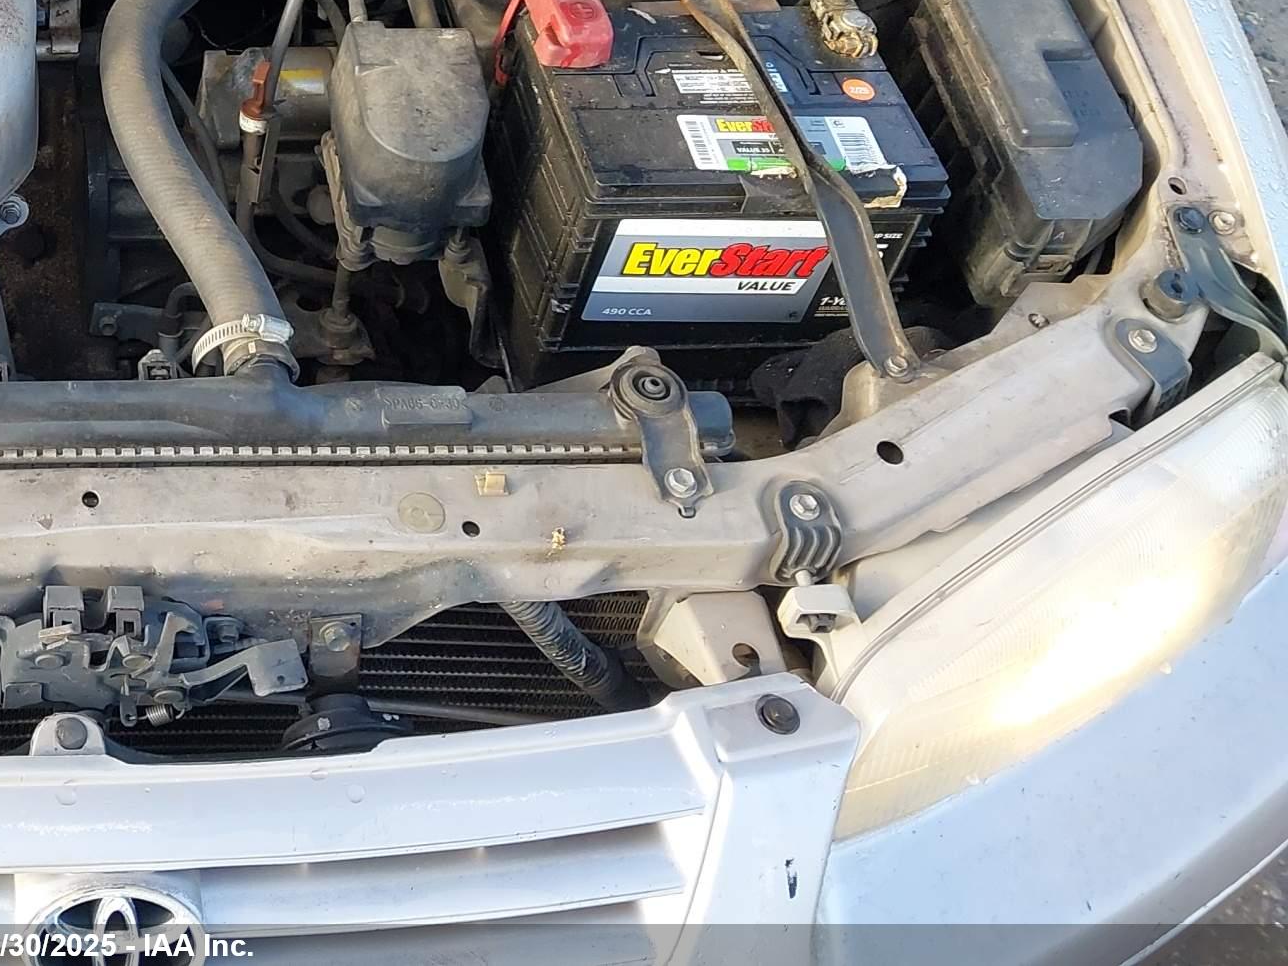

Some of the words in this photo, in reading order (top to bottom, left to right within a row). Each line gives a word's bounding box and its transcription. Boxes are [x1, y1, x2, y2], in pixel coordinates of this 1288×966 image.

[715, 119, 776, 133] EverSt
[621, 240, 831, 278] EverStart
[736, 280, 793, 292] VALUE
[601, 306, 626, 316] 490
[628, 306, 653, 316] CCA
